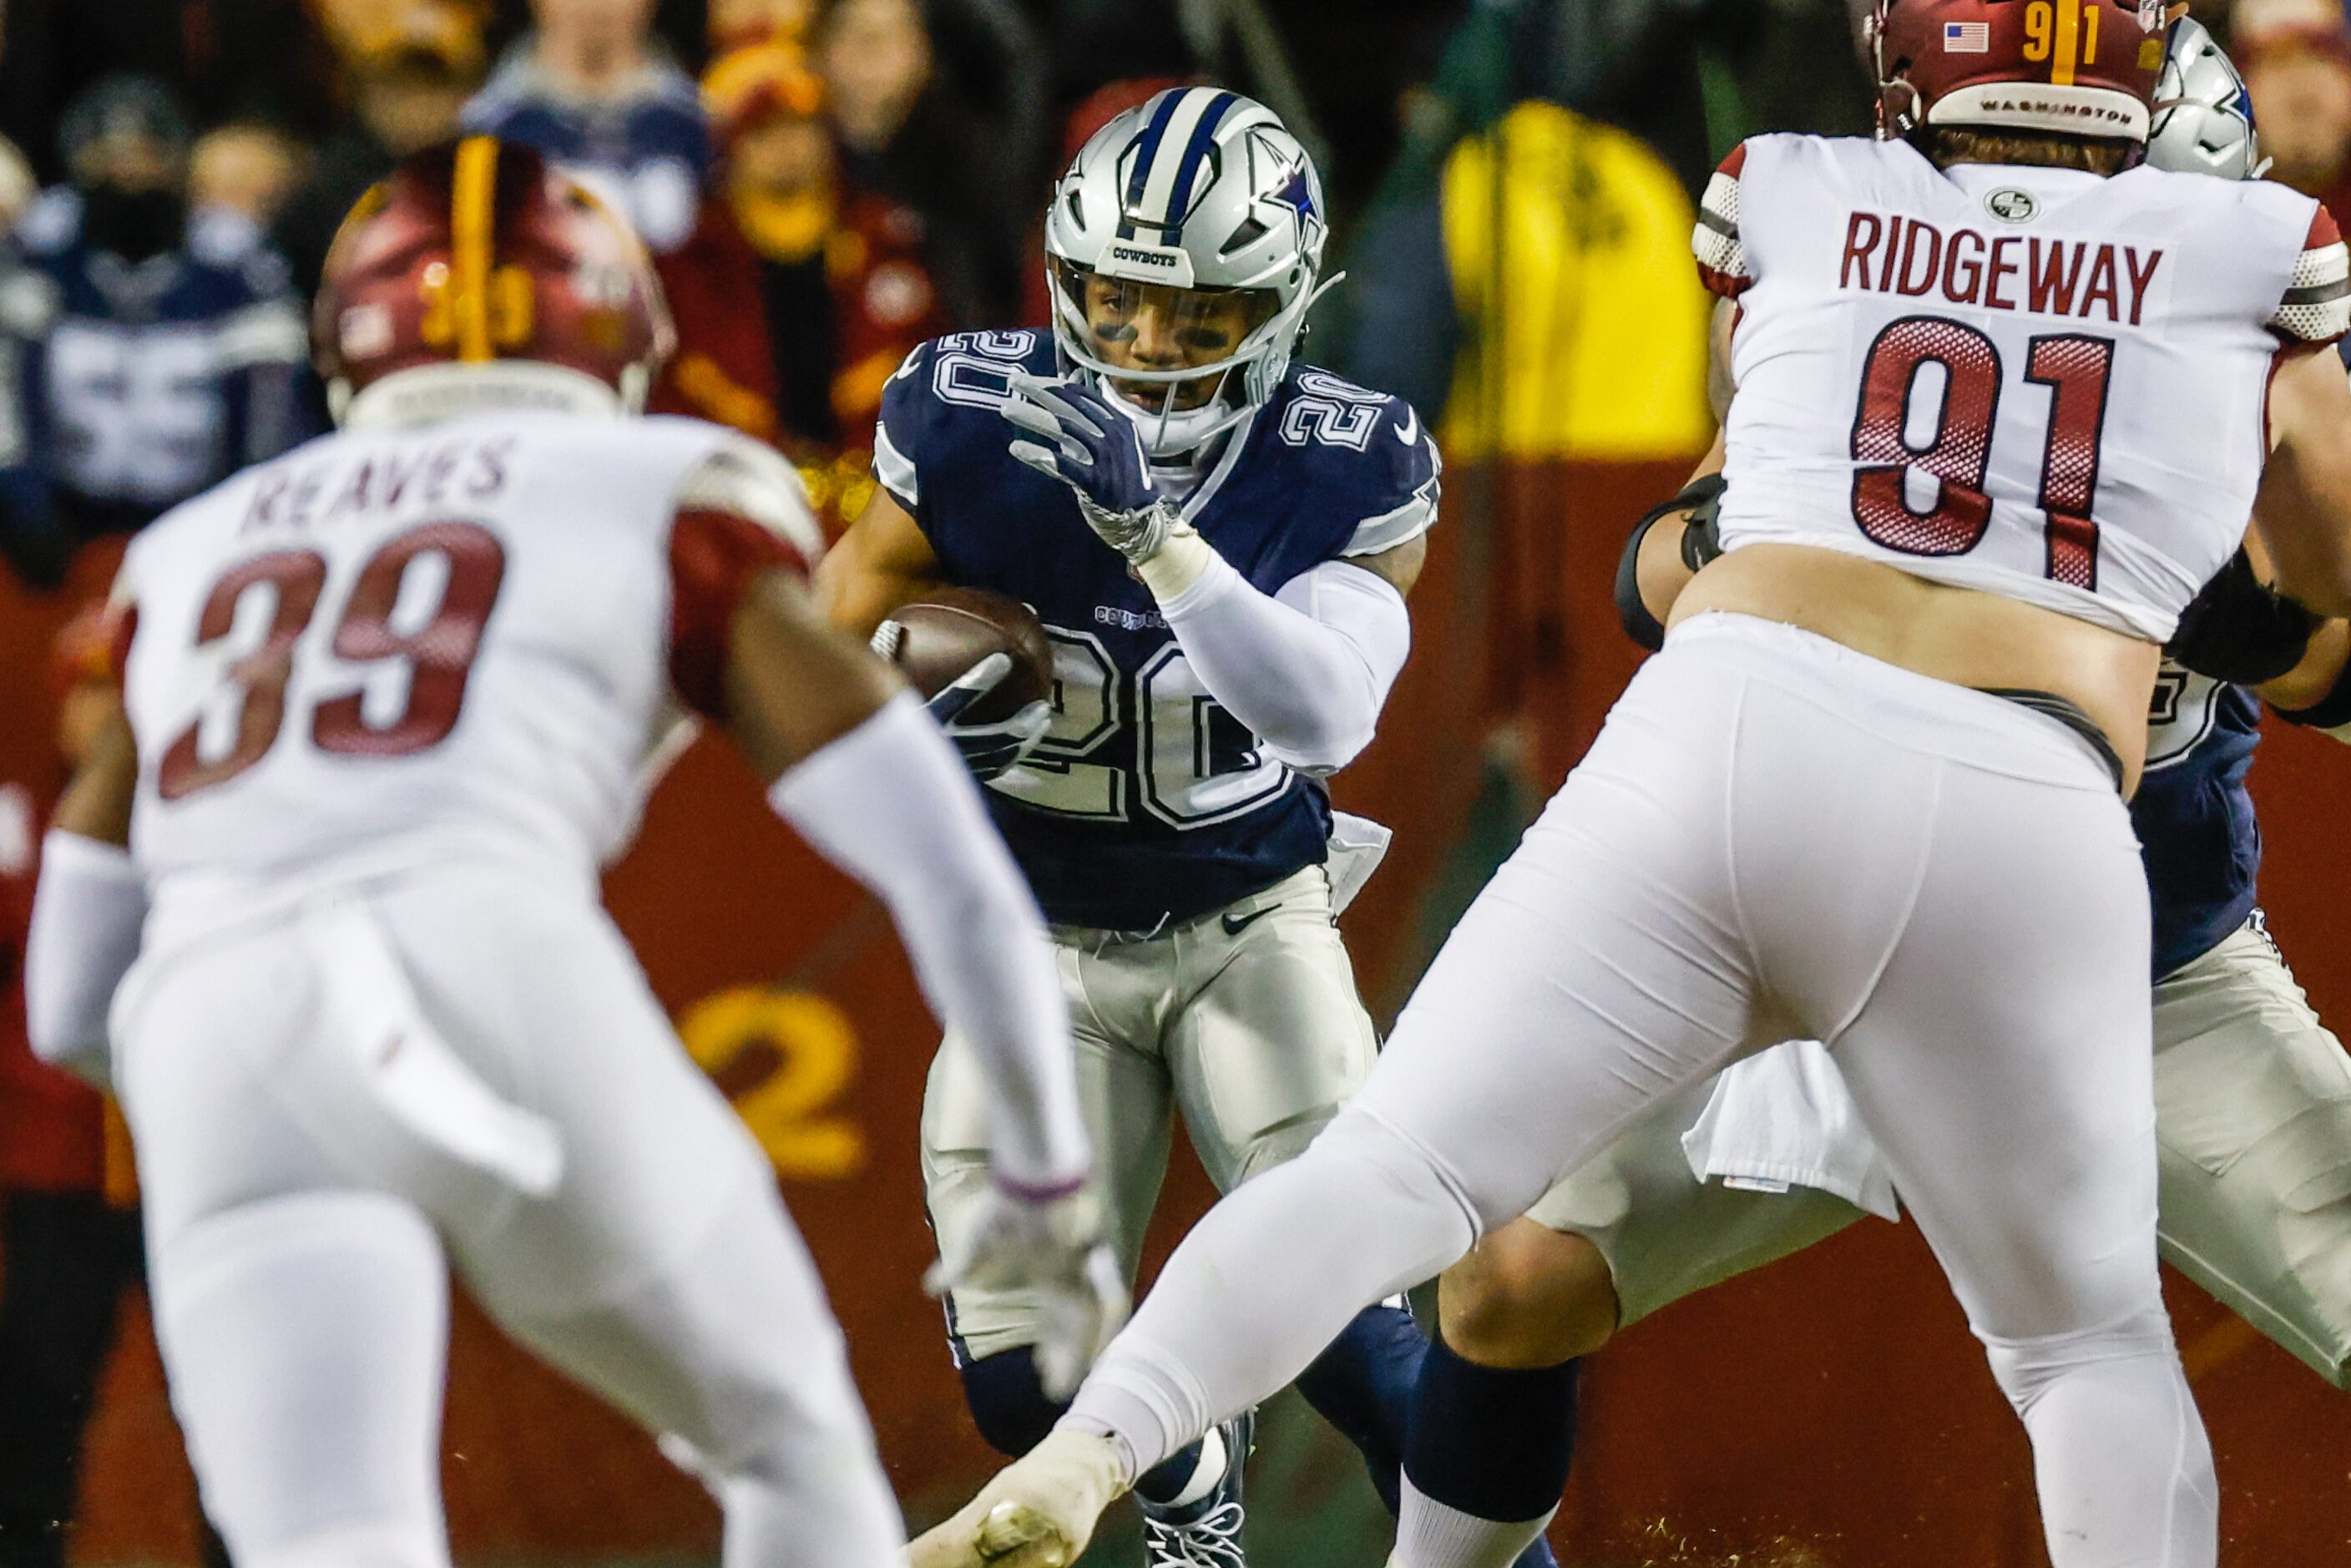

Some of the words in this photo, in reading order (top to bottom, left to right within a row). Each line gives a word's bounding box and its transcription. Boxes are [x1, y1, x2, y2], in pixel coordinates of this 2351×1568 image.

[2023, 1, 2100, 65] 91
[1980, 100, 2133, 125] WASHINGTON
[1113, 247, 1177, 268] COWBOYS
[1839, 210, 2164, 326] RIDGEWAY
[1278, 372, 1396, 453] 20
[1851, 315, 2115, 591] 91
[239, 436, 518, 539] REAVES
[159, 519, 506, 802] 39
[985, 624, 1296, 832] 20
